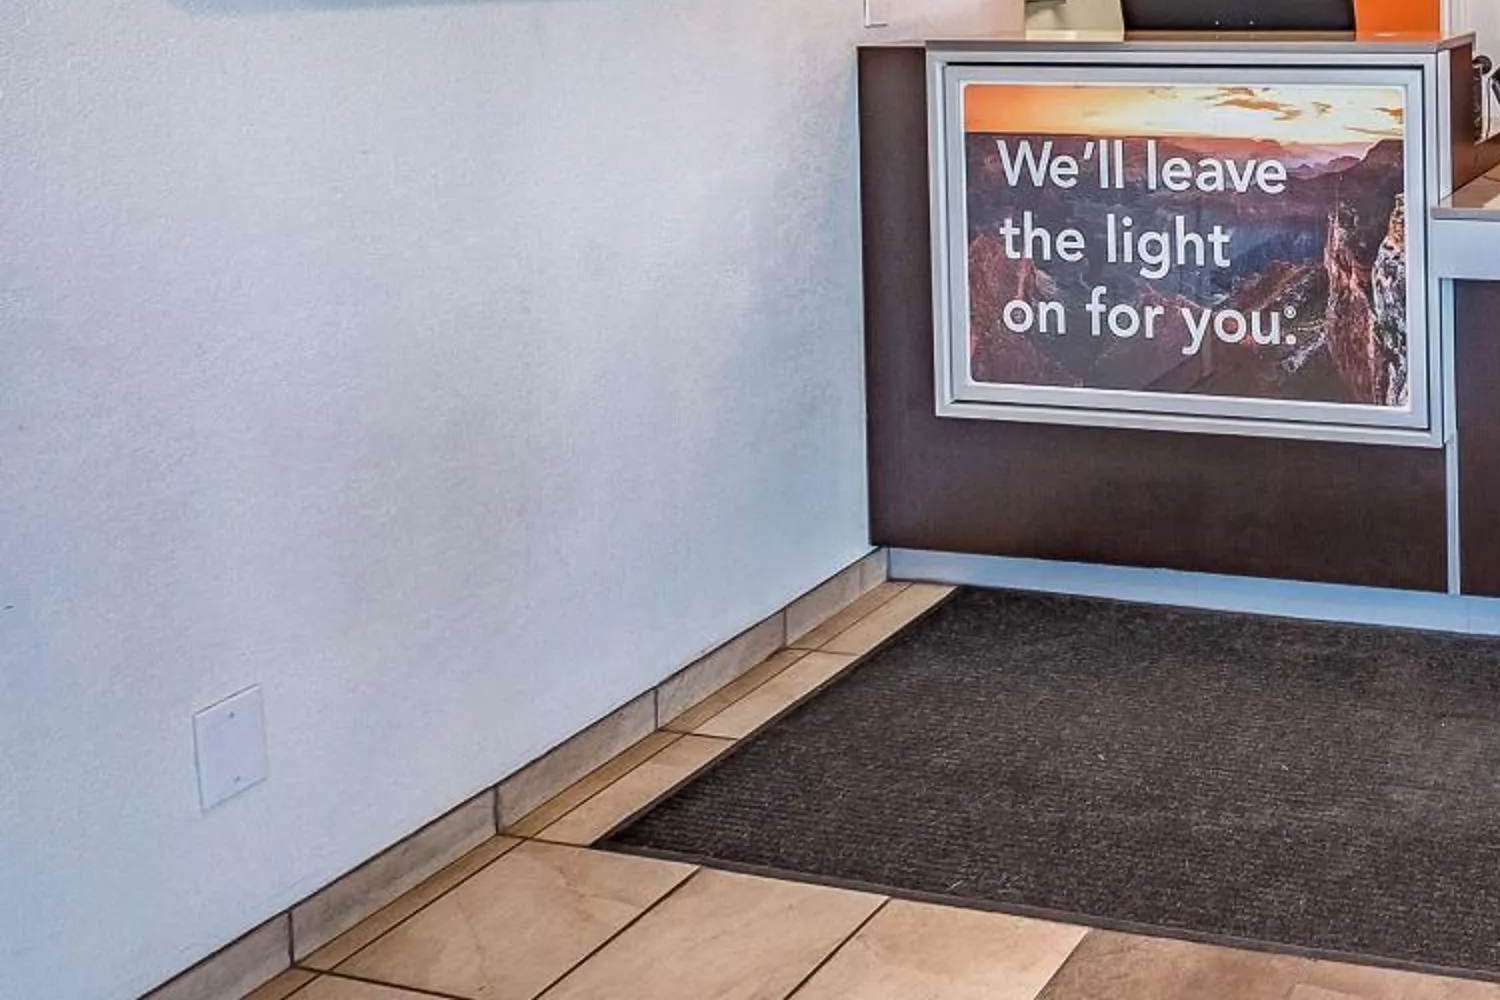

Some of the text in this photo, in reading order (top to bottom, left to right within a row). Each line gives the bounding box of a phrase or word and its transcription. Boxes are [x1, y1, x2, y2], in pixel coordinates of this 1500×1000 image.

[996, 139, 1287, 195] We'll leave
[1000, 211, 1231, 279] the light
[1002, 299, 1066, 336] on
[1086, 286, 1164, 339] for
